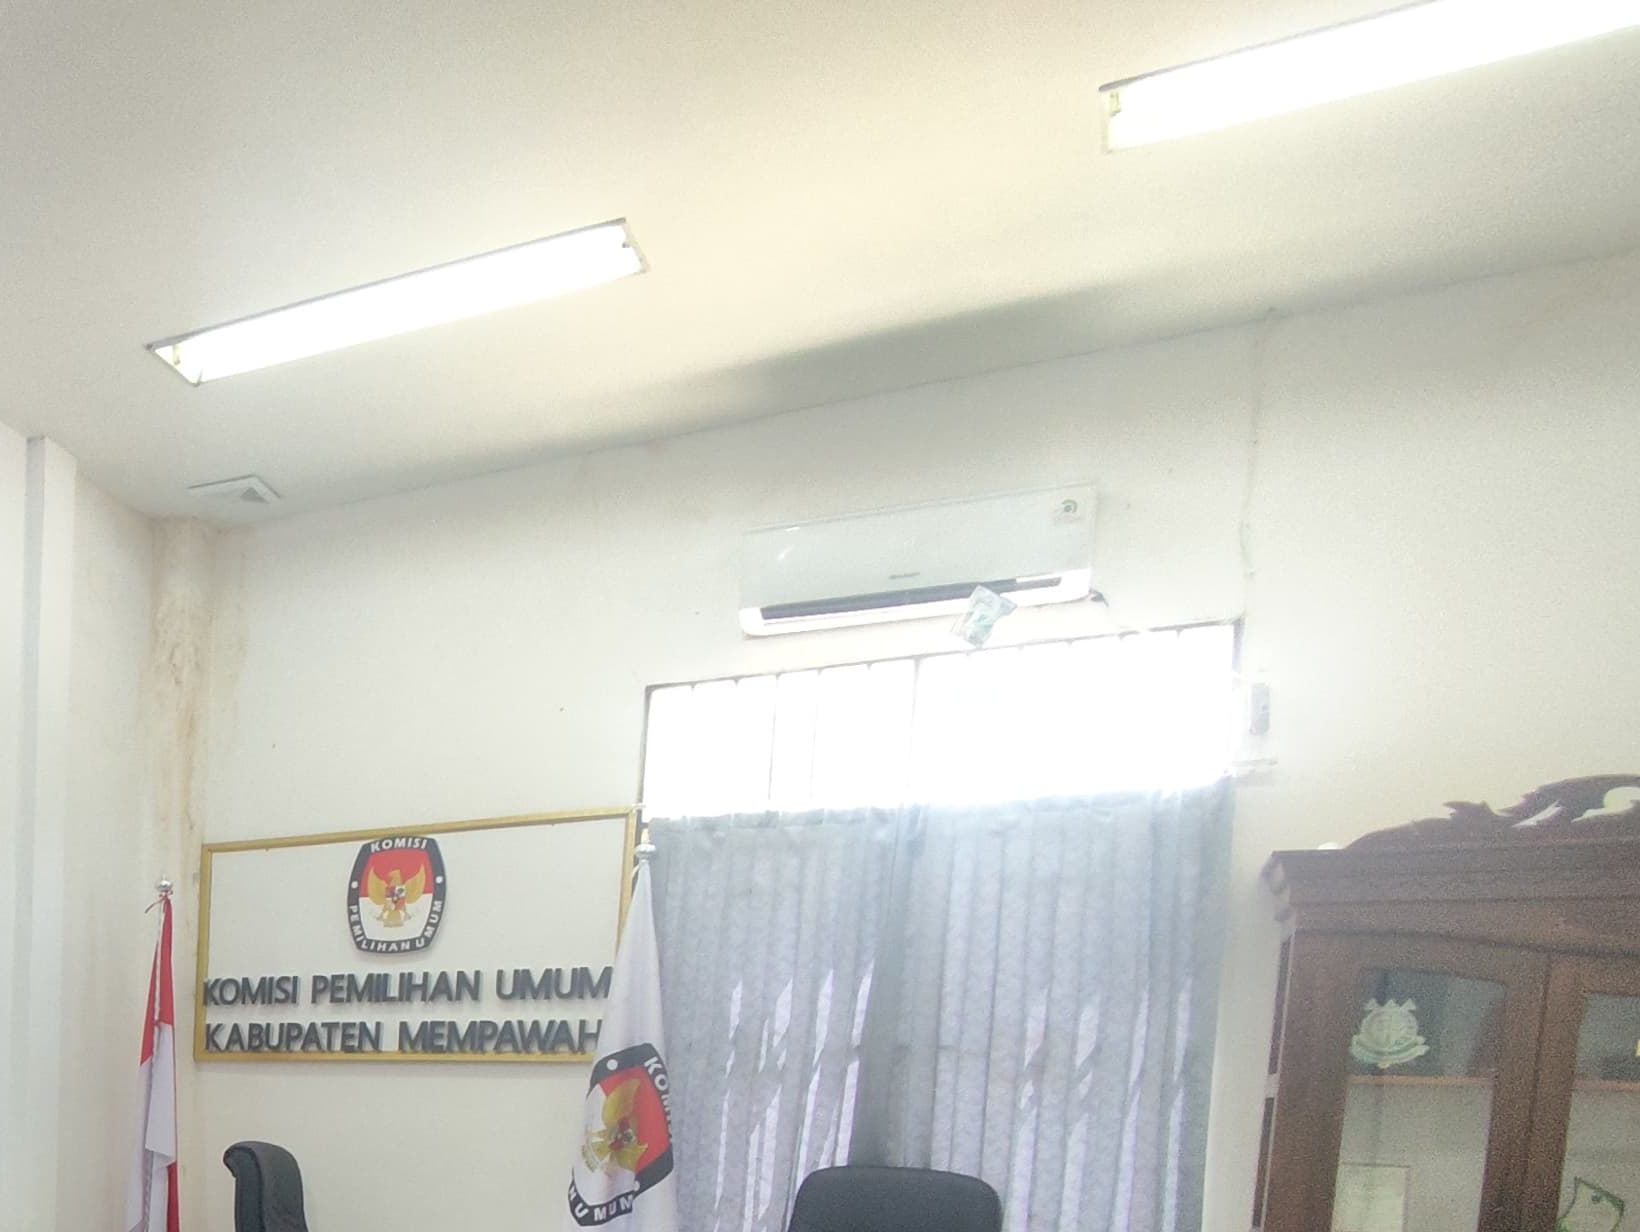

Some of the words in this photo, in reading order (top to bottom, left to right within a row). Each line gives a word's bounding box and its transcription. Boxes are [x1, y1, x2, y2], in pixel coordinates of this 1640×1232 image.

[370, 837, 428, 853] KOMISI
[349, 904, 411, 952] PEMILIHAN
[414, 900, 443, 947] UMUM
[203, 975, 299, 1006] KOMISI
[311, 970, 481, 1004] PEMILIHAN
[496, 965, 614, 1001] UMUM
[205, 1021, 382, 1054] KABUPATEN
[397, 1018, 603, 1055] MEMPAWAH
